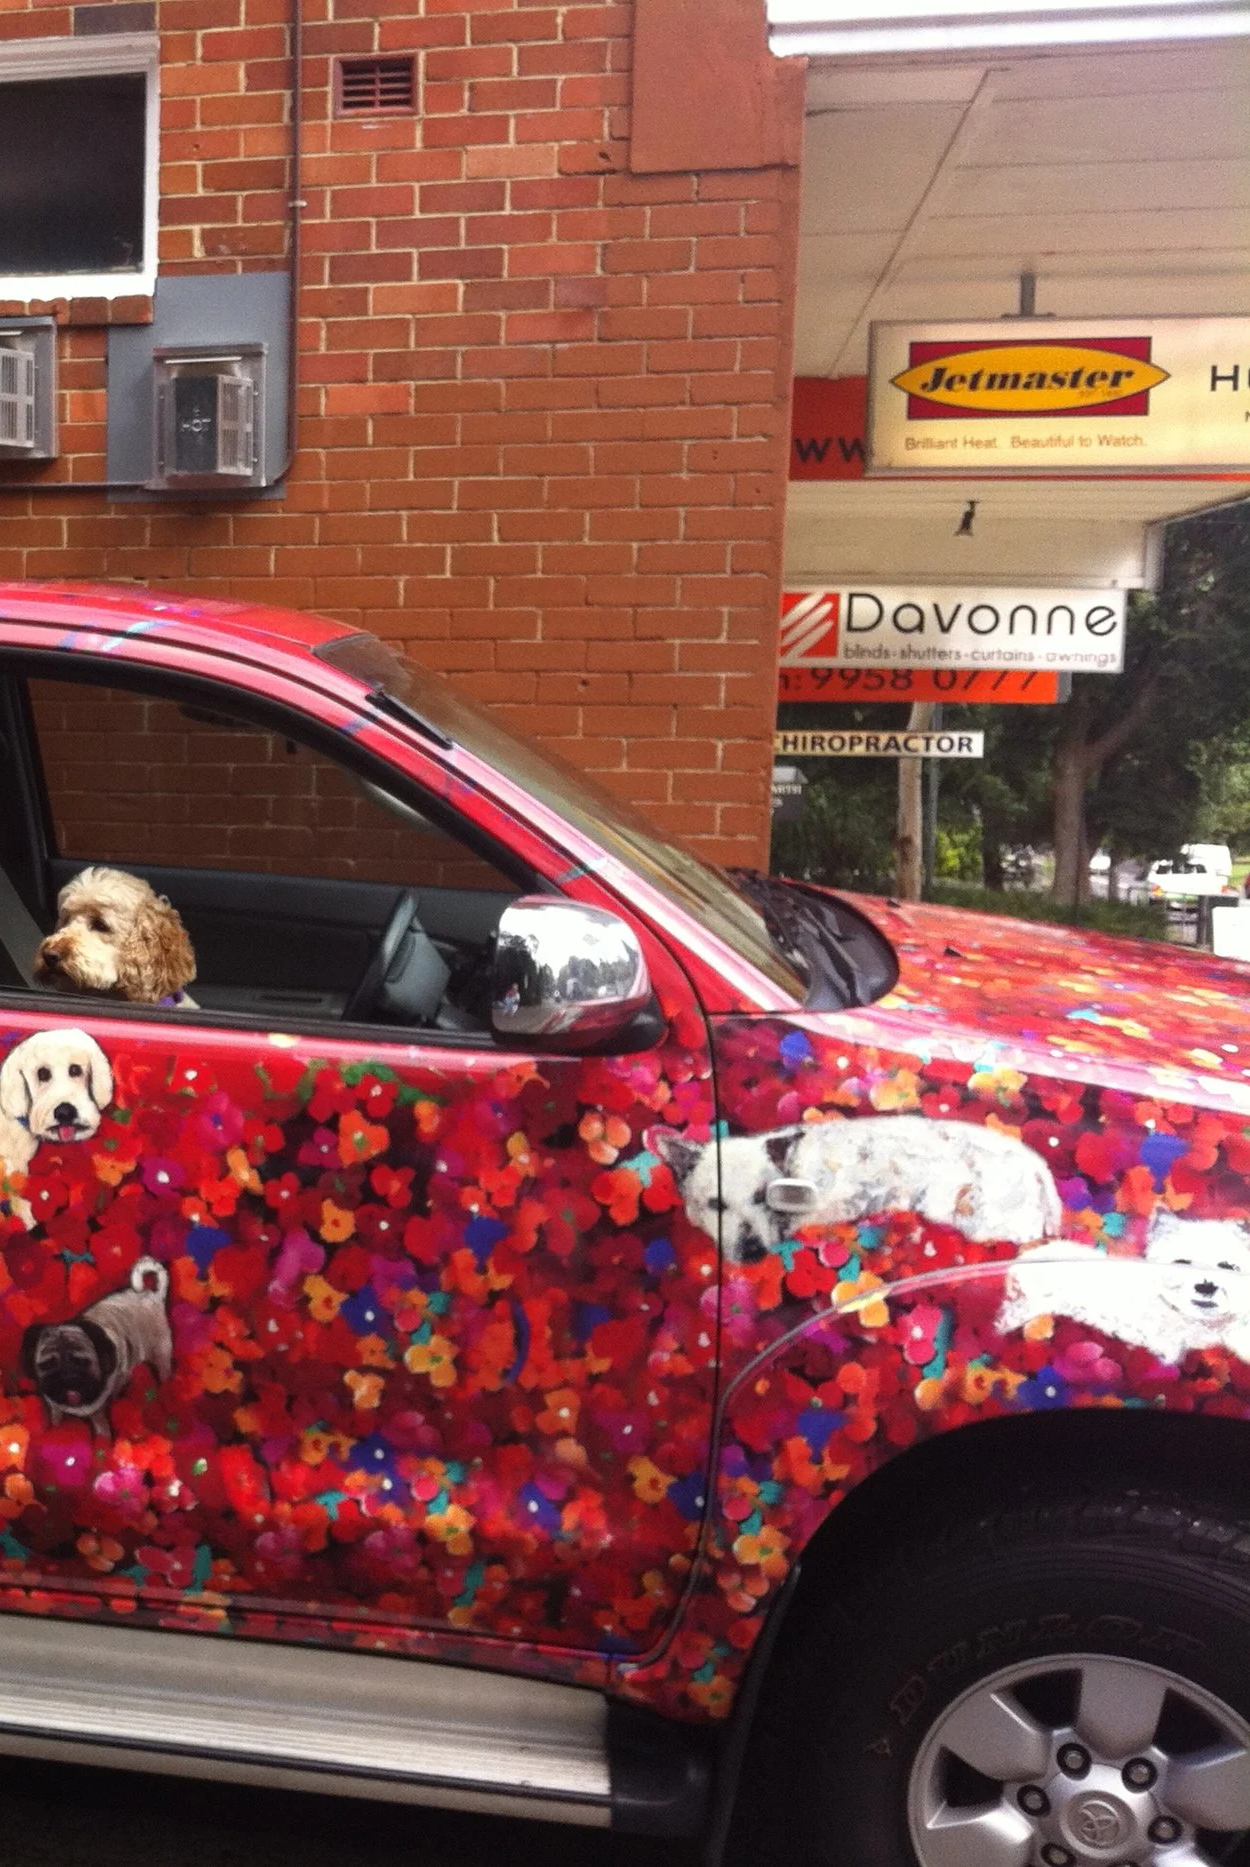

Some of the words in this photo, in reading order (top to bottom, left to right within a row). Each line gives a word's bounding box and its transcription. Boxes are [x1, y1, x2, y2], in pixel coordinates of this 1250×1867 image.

[920, 364, 1135, 393] Jetmaster
[905, 437, 957, 450] Brilliant
[1011, 434, 1075, 449] Beautiful
[1079, 435, 1092, 447] to
[846, 592, 1117, 637] Davonne
[773, 735, 974, 754] HIROPRACTOR
